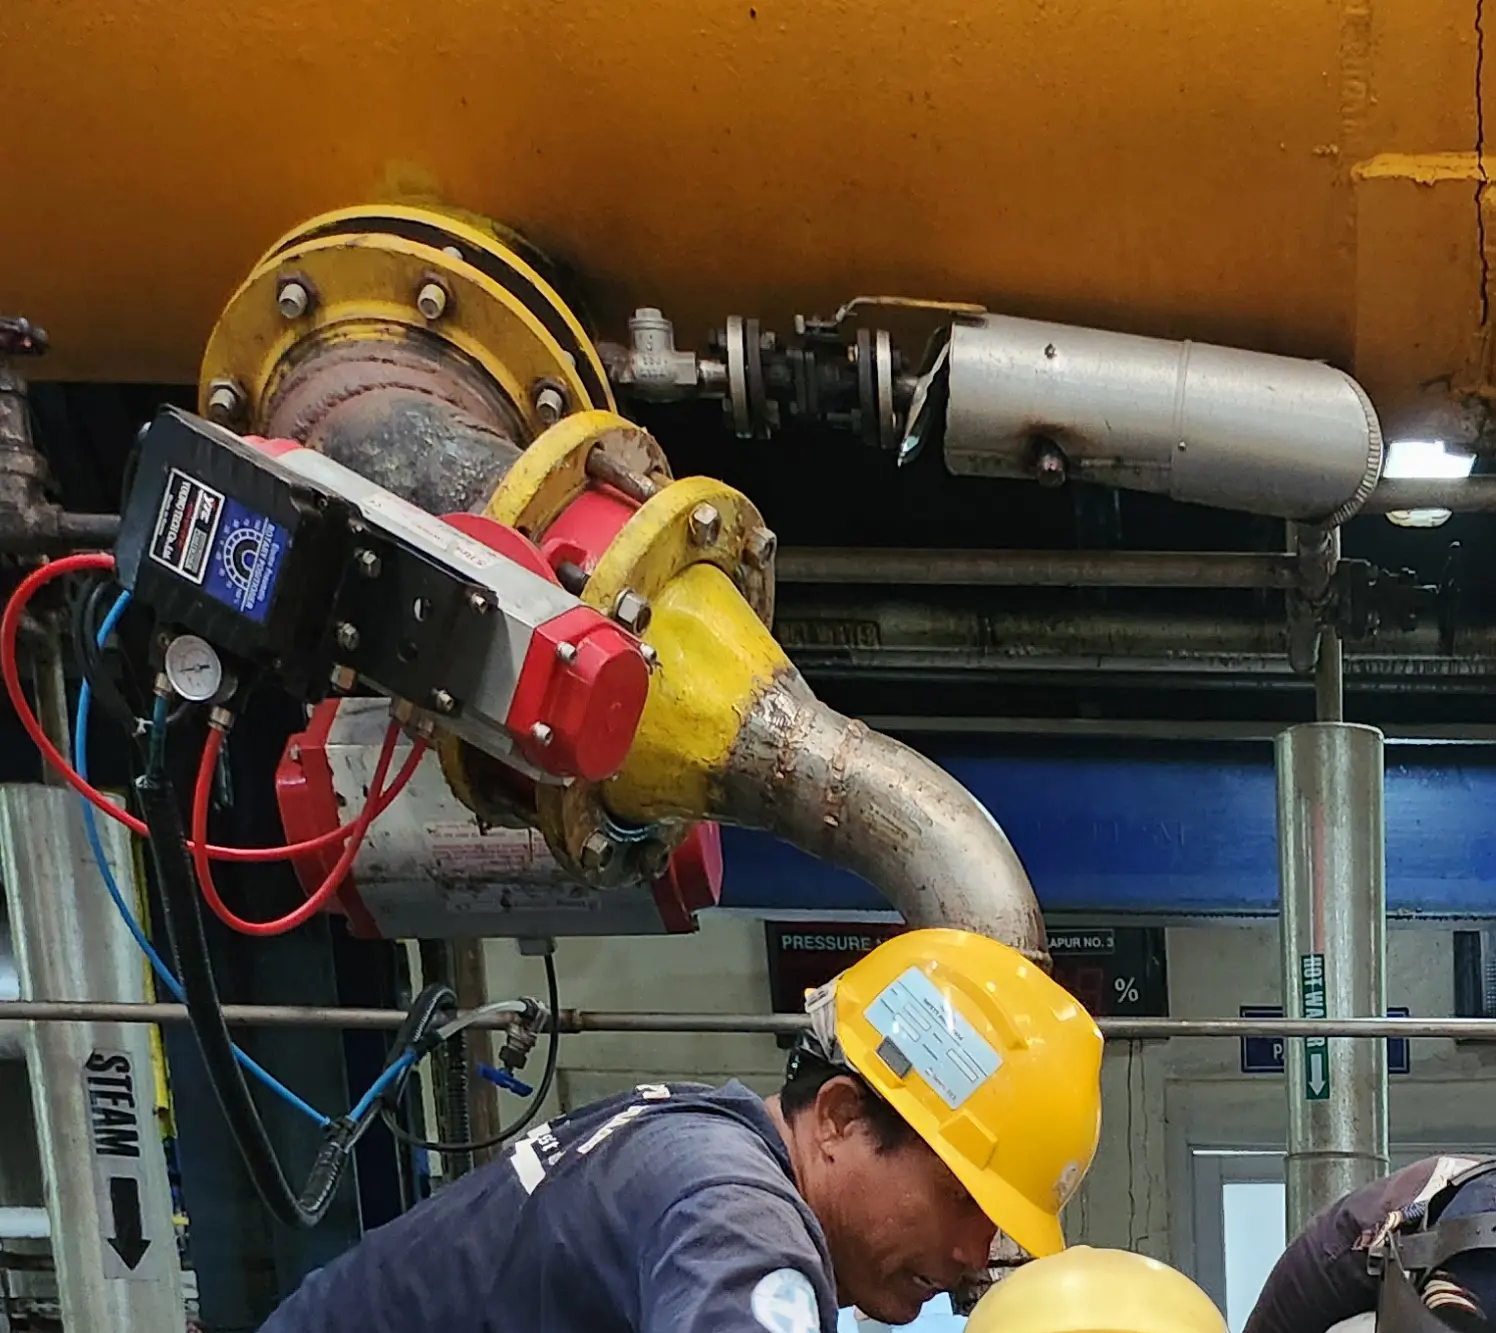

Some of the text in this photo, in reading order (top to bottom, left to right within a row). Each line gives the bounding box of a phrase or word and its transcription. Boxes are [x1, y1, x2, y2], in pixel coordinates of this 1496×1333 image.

[781, 935, 873, 951] PRESSURE
[1047, 937, 1081, 949] APUR
[1114, 976, 1139, 1003] %
[1303, 957, 1326, 1048] HOT WAR
[85, 1053, 140, 1158] STEAM
